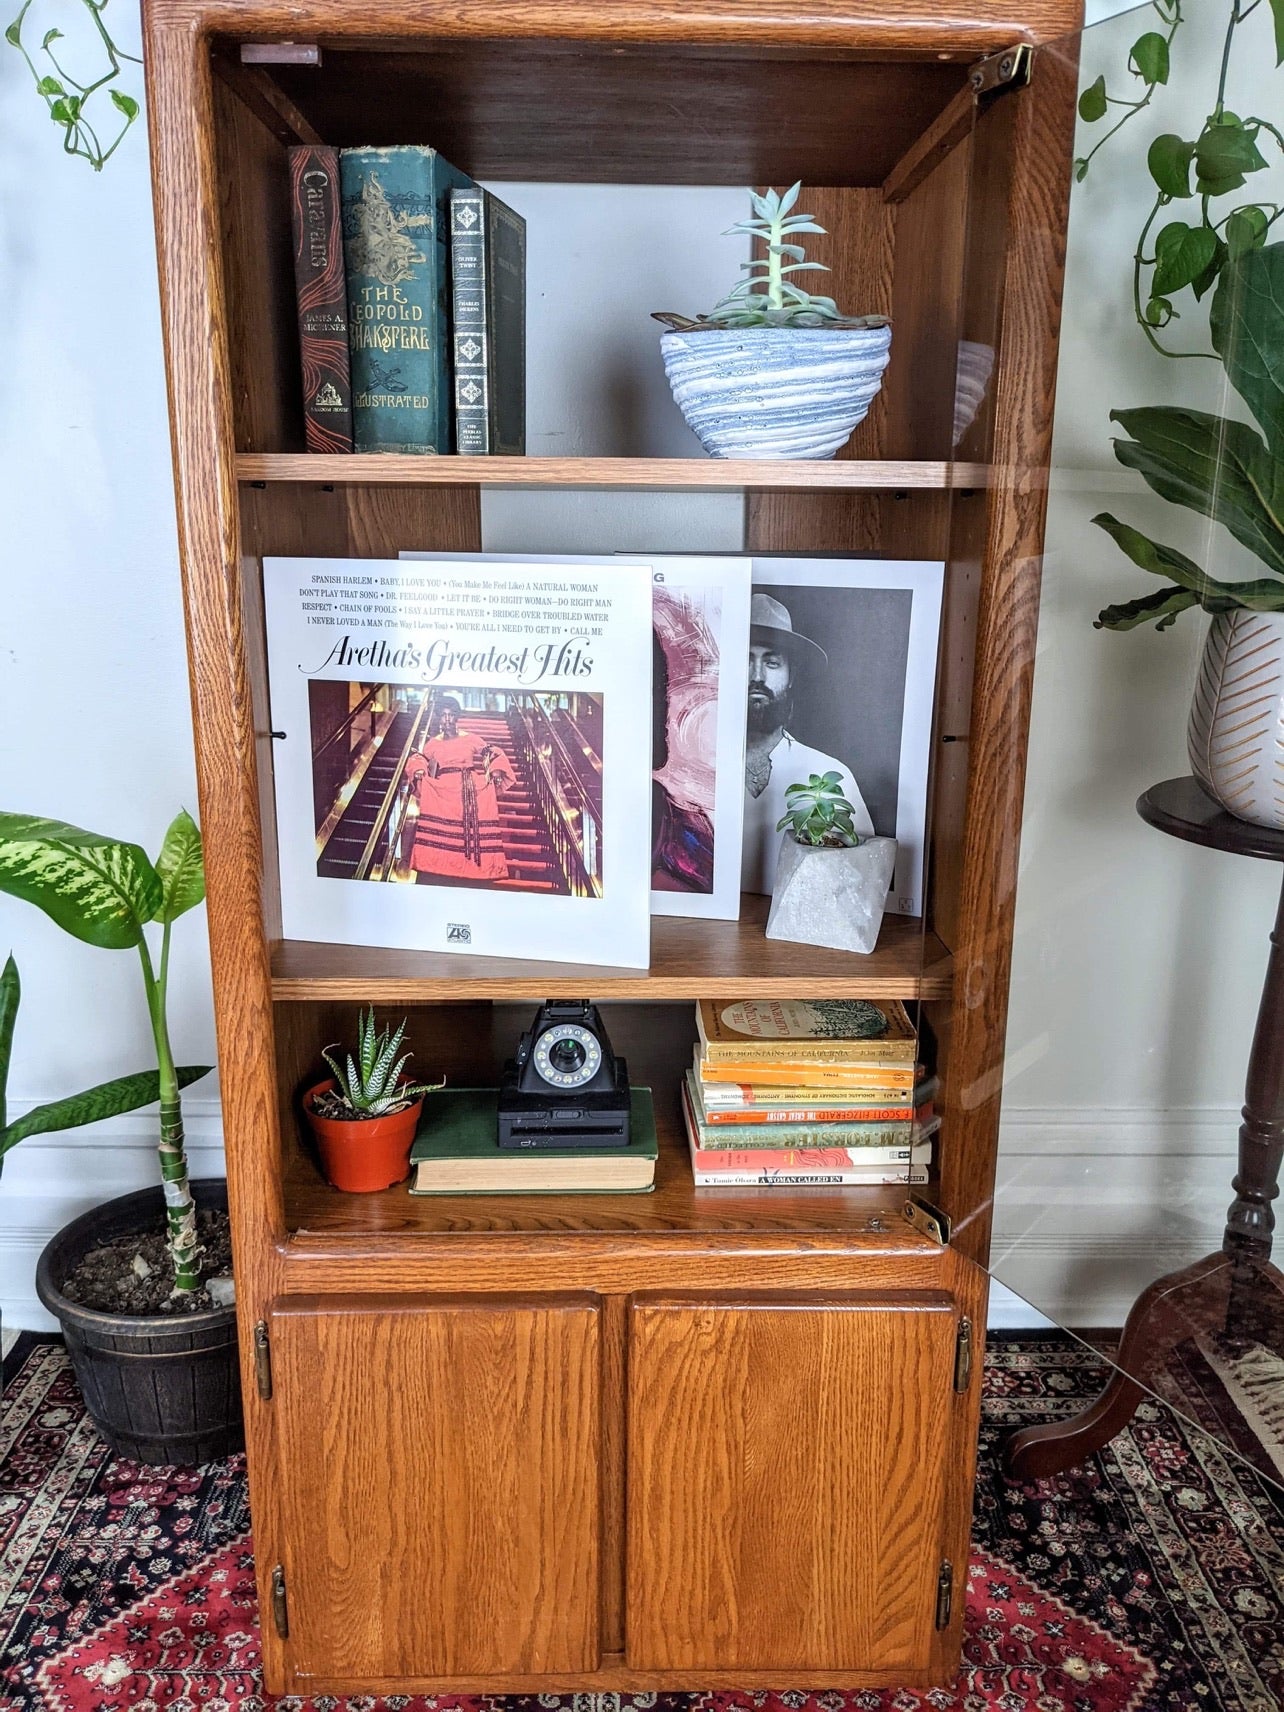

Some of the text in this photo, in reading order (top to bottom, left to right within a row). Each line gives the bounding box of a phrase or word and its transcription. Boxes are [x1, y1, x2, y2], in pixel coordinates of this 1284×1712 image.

[303, 170, 328, 267] Caravans
[361, 287, 408, 304] THE
[334, 314, 344, 322] A.
[351, 301, 422, 324] LEOPOLD
[350, 324, 430, 352] SHAKSPERE
[312, 575, 341, 584] SPANISH
[343, 576, 372, 585] HARLEM
[406, 579, 425, 587] LOVE
[426, 579, 441, 587] YOU
[448, 580, 462, 588] (You
[464, 580, 481, 589] Make
[482, 581, 492, 589] Me
[494, 581, 507, 590] Feel
[508, 582, 524, 590] Like)
[532, 583, 568, 592] NATURAL
[570, 584, 598, 592] WOMAN
[300, 589, 319, 597] DON'T
[360, 591, 378, 599] SONG
[399, 592, 438, 601] FEELGOOD
[500, 596, 523, 604] RIGHT
[570, 598, 594, 607] RIGHT
[595, 599, 612, 607] MAN
[302, 602, 332, 611] RESPECT
[339, 604, 362, 612] CHAIN
[374, 605, 397, 613] FOOLS
[408, 606, 423, 615] SAY
[429, 607, 455, 616] LITTLE
[456, 609, 485, 617] PRAYER
[492, 610, 520, 618] BRIDGE
[543, 612, 582, 621] TROUBLED
[584, 613, 608, 622] WATER
[337, 618, 359, 626] LOVED
[384, 620, 398, 628] (The
[400, 620, 412, 629] Way
[418, 621, 433, 629] Love
[434, 621, 448, 630] You)
[456, 623, 480, 631] YOU'RE
[502, 625, 522, 633] NEED
[524, 625, 534, 633] TO
[535, 626, 550, 634] GET
[570, 627, 590, 635] CALL
[298, 636, 594, 684] Aretha's Greatest Hits
[760, 1014, 772, 1023] OF
[766, 1112, 787, 1120] GATSBY
[789, 1112, 805, 1120] GREAT
[808, 1112, 816, 1120] THE
[819, 1111, 874, 1120] FITZGERALD
[784, 1132, 872, 1147] FORSTER
